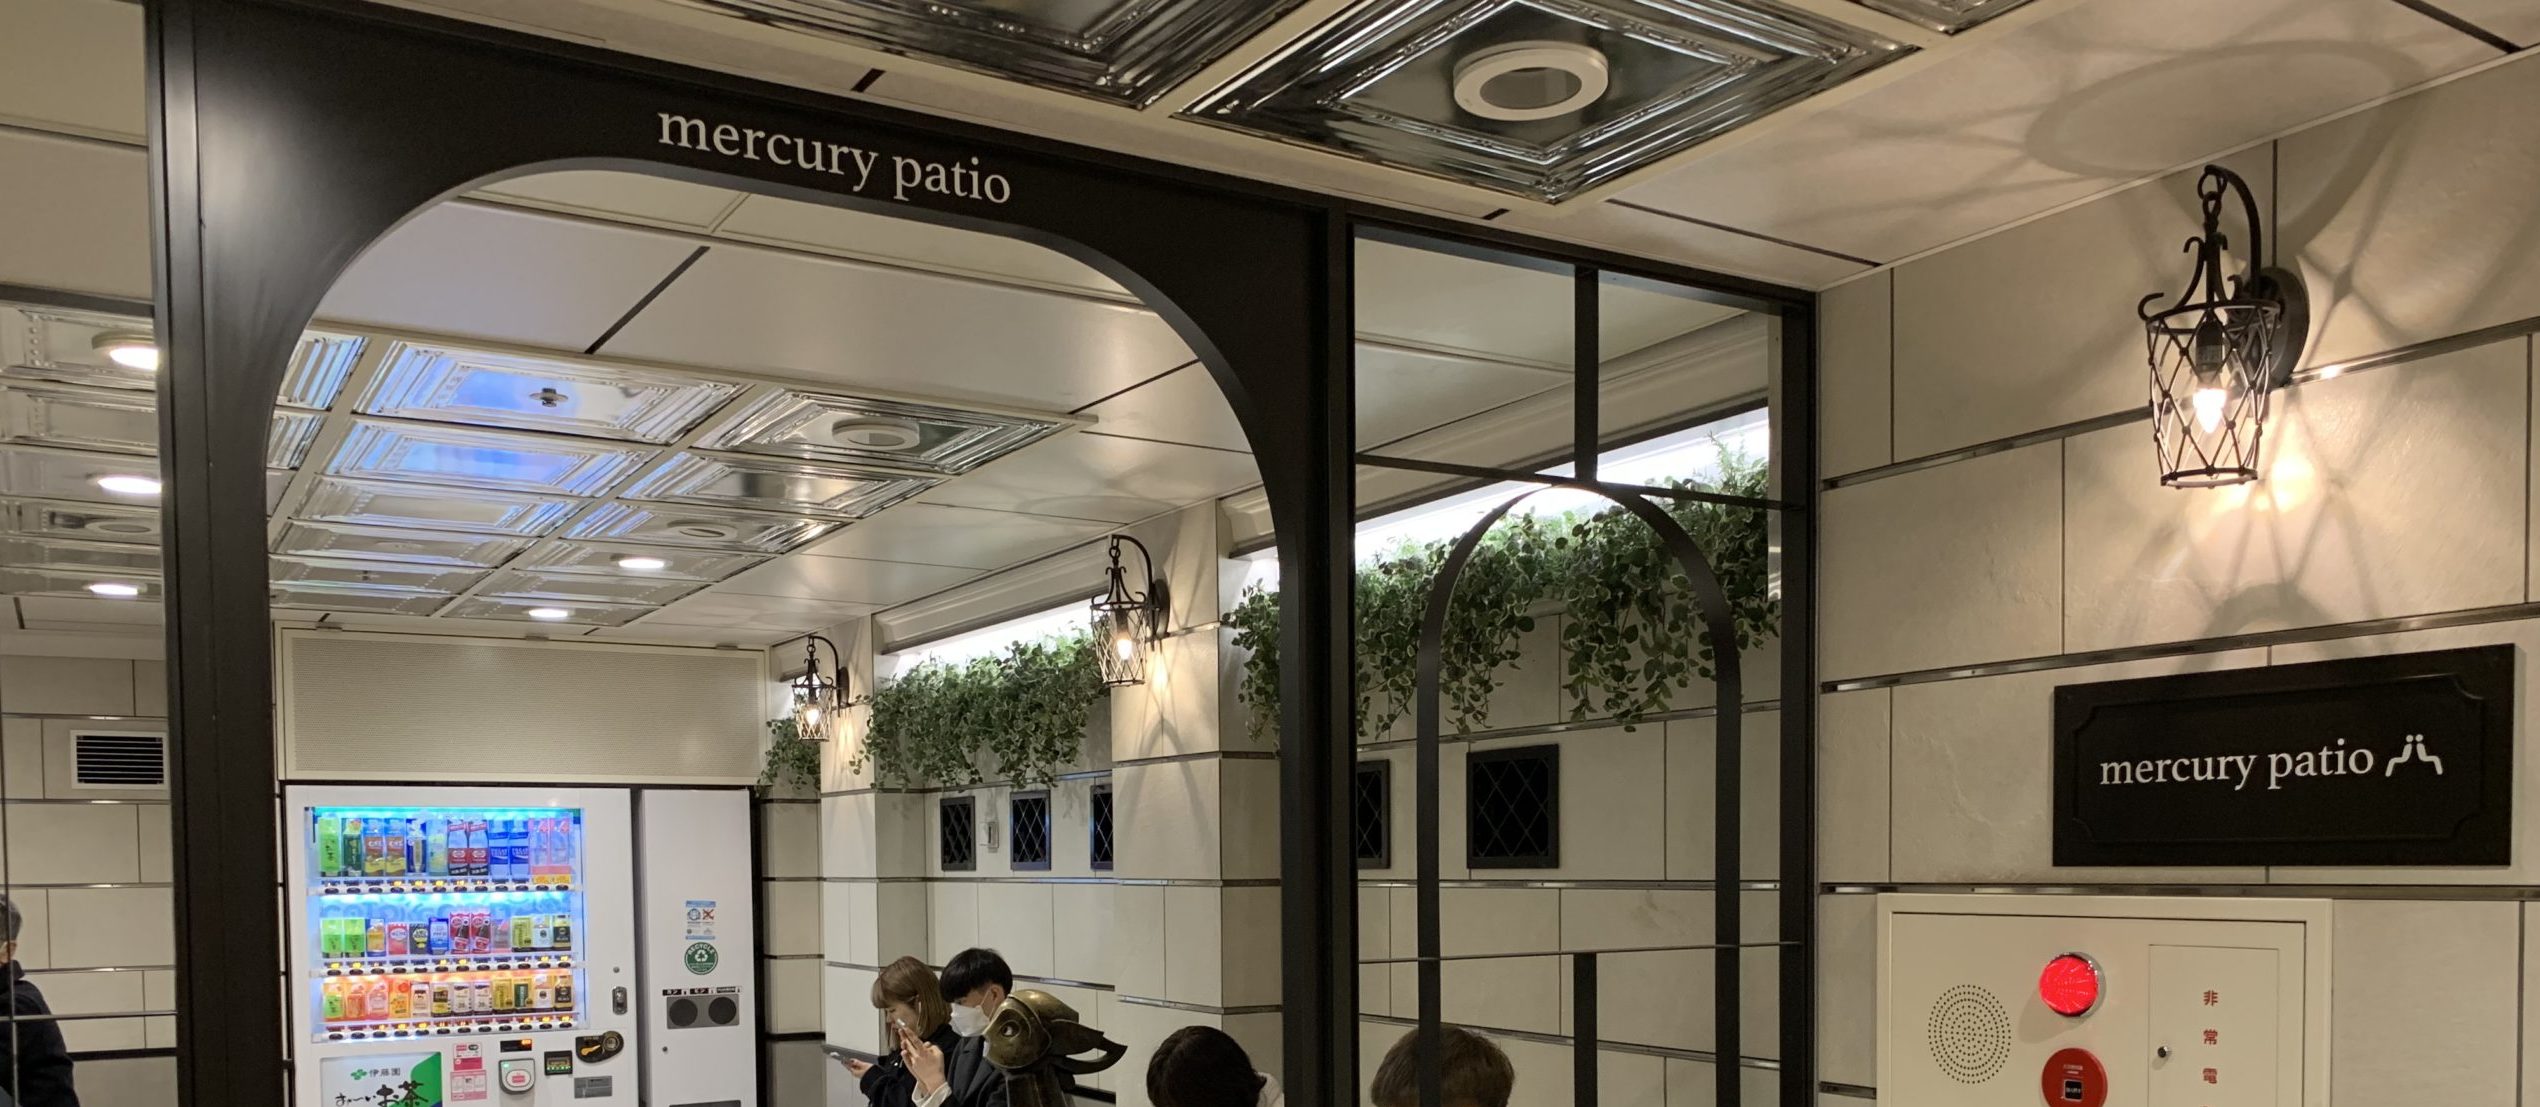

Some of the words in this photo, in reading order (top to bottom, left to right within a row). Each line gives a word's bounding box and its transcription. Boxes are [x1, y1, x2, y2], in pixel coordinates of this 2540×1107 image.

[657, 111, 879, 193] mercury
[891, 156, 1011, 204] patio
[2099, 753, 2258, 792] mercury
[2267, 737, 2375, 790] patio
[687, 942, 716, 955] RECYCLE
[2202, 989, 2219, 1107] 非常電
